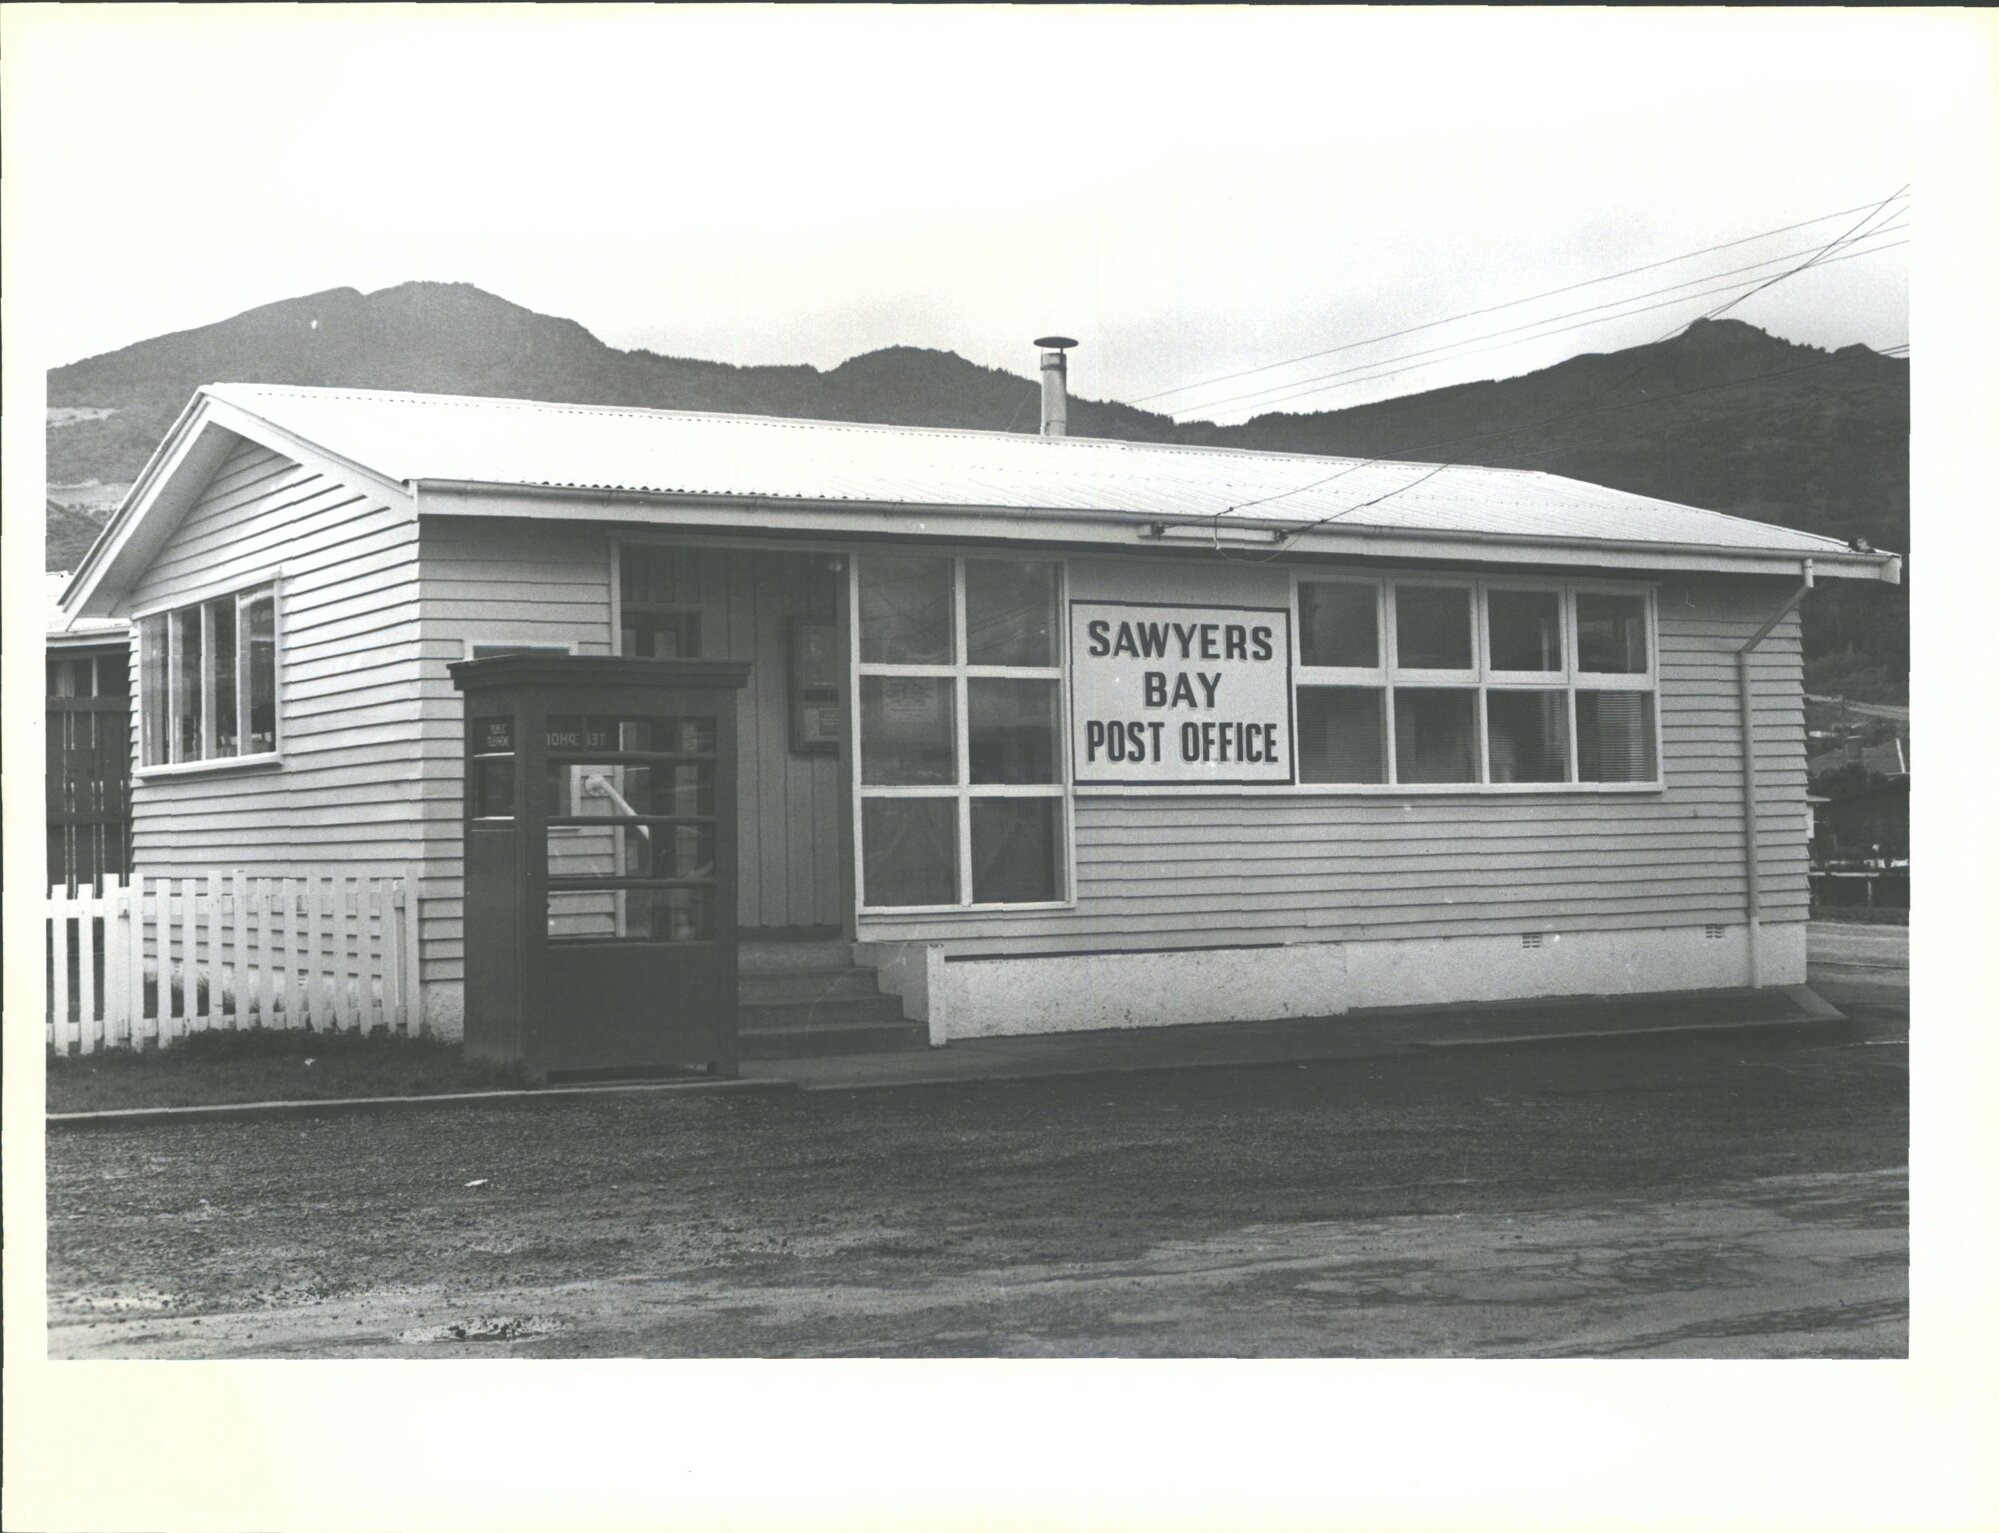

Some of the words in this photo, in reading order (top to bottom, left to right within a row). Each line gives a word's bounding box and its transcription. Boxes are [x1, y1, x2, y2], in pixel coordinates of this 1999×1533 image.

[1088, 620, 1273, 661] SAWYERS
[1145, 671, 1222, 708] BAY
[1086, 720, 1165, 763] POST
[1181, 722, 1278, 764] OFFICE
